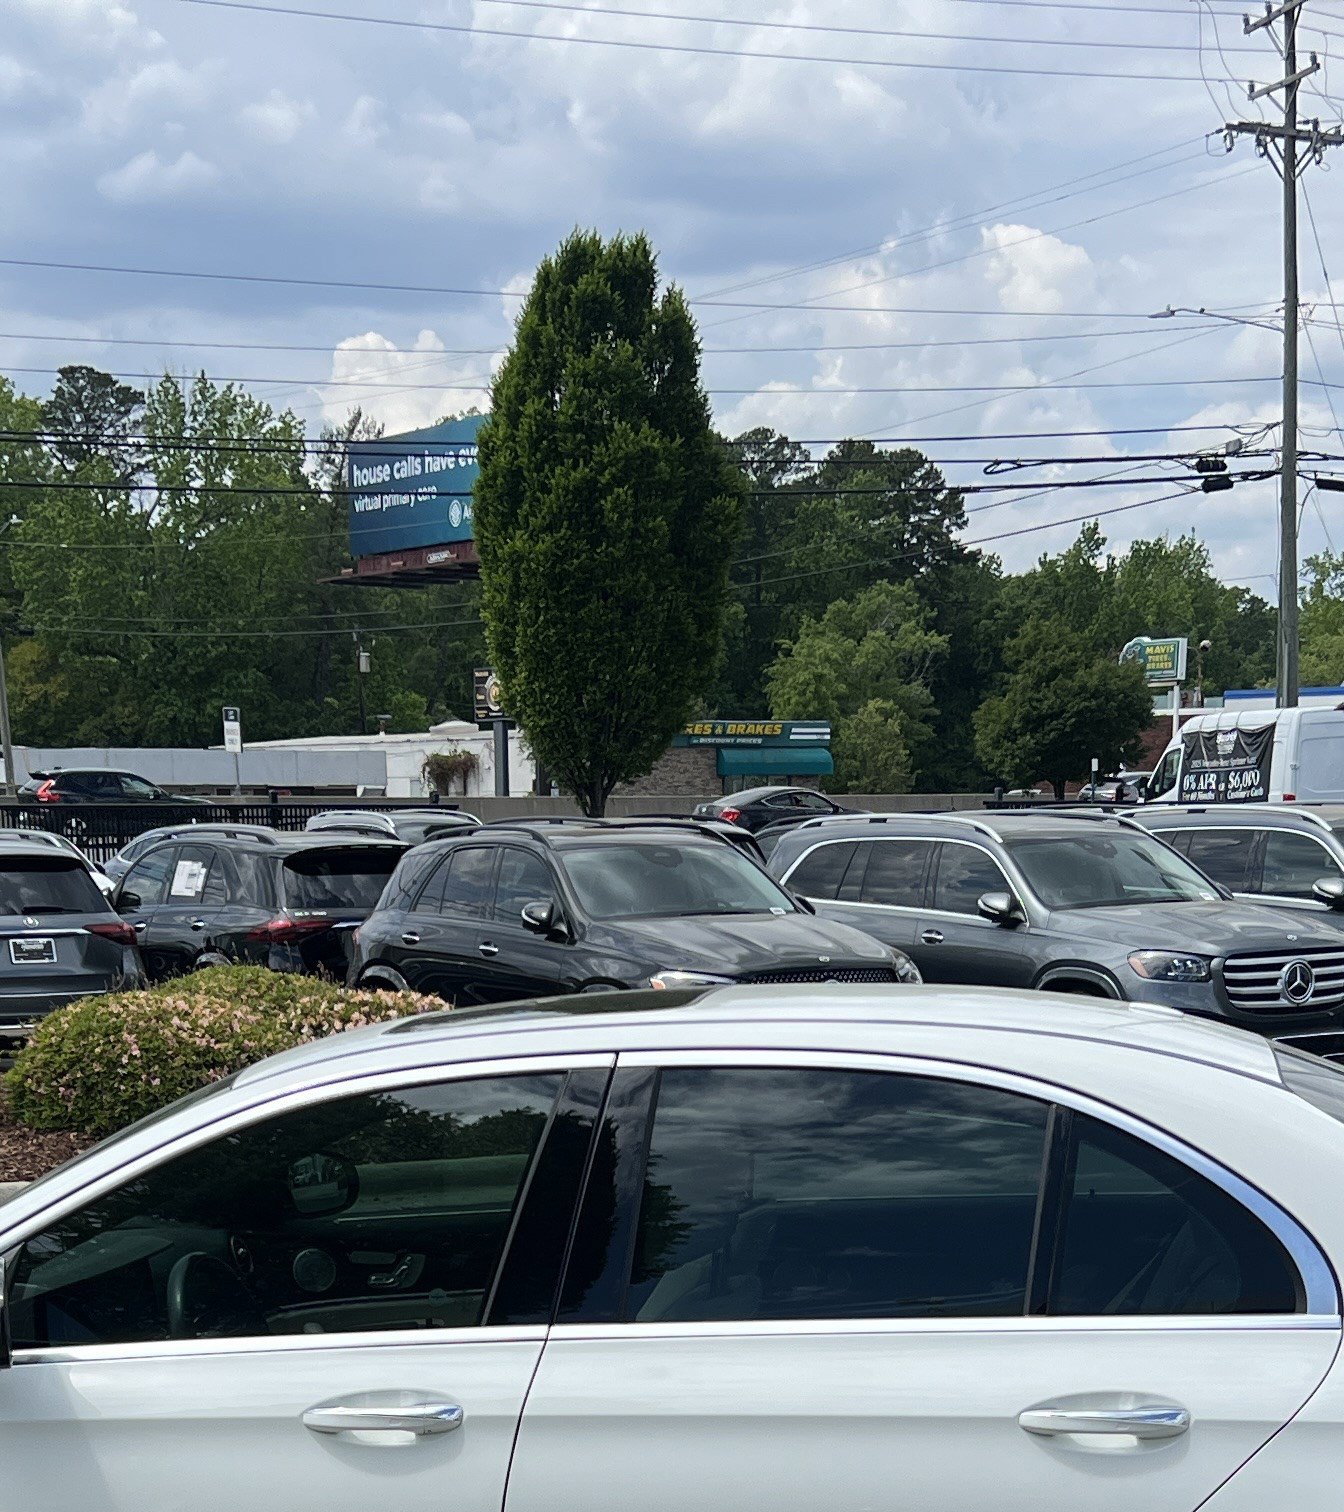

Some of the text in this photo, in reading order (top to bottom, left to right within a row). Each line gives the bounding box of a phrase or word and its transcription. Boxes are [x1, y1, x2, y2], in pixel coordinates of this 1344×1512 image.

[353, 464, 391, 487] house
[393, 455, 422, 480] calls
[424, 450, 456, 474] have
[354, 485, 437, 513] virtual primary care
[1145, 644, 1174, 654] MAVIS
[726, 724, 783, 735] BRAKES
[1183, 774, 1196, 790] 0%
[1197, 773, 1217, 790] APR
[1228, 769, 1260, 791] $6,000
